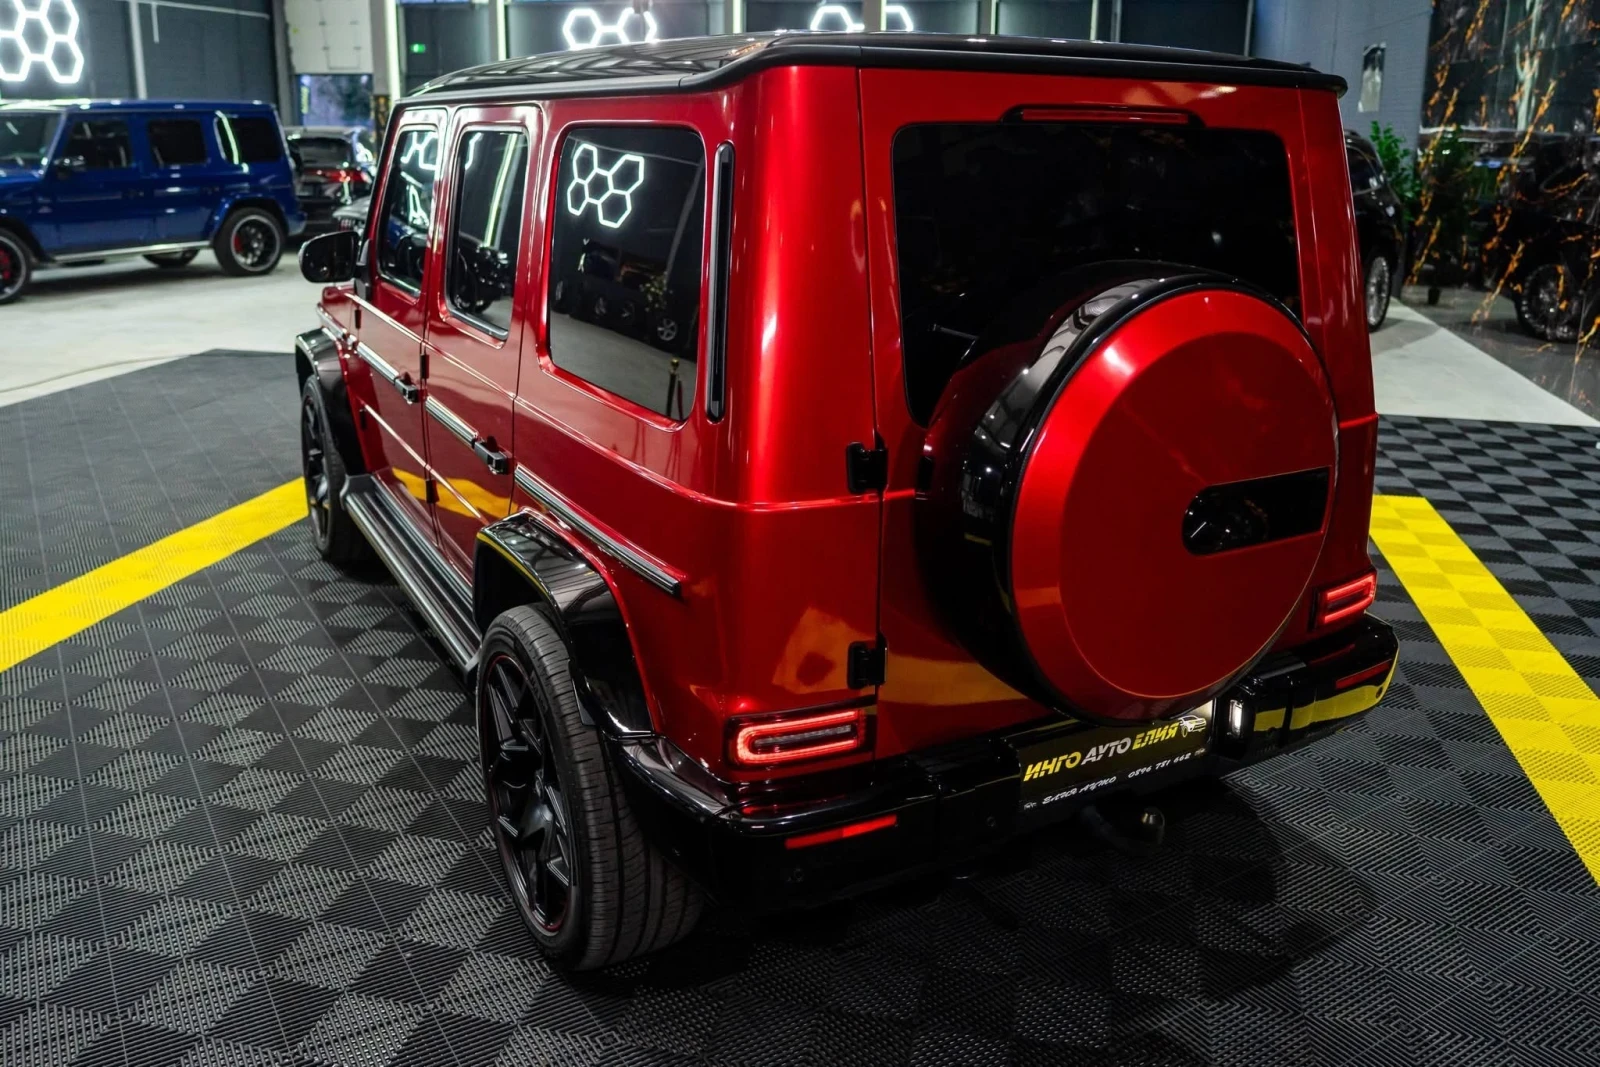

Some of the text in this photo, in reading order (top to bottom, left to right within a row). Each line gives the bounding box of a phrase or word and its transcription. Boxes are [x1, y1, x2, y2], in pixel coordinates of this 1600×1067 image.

[1023, 721, 1179, 781] ИНГО АУТО ЕЛИЯ
